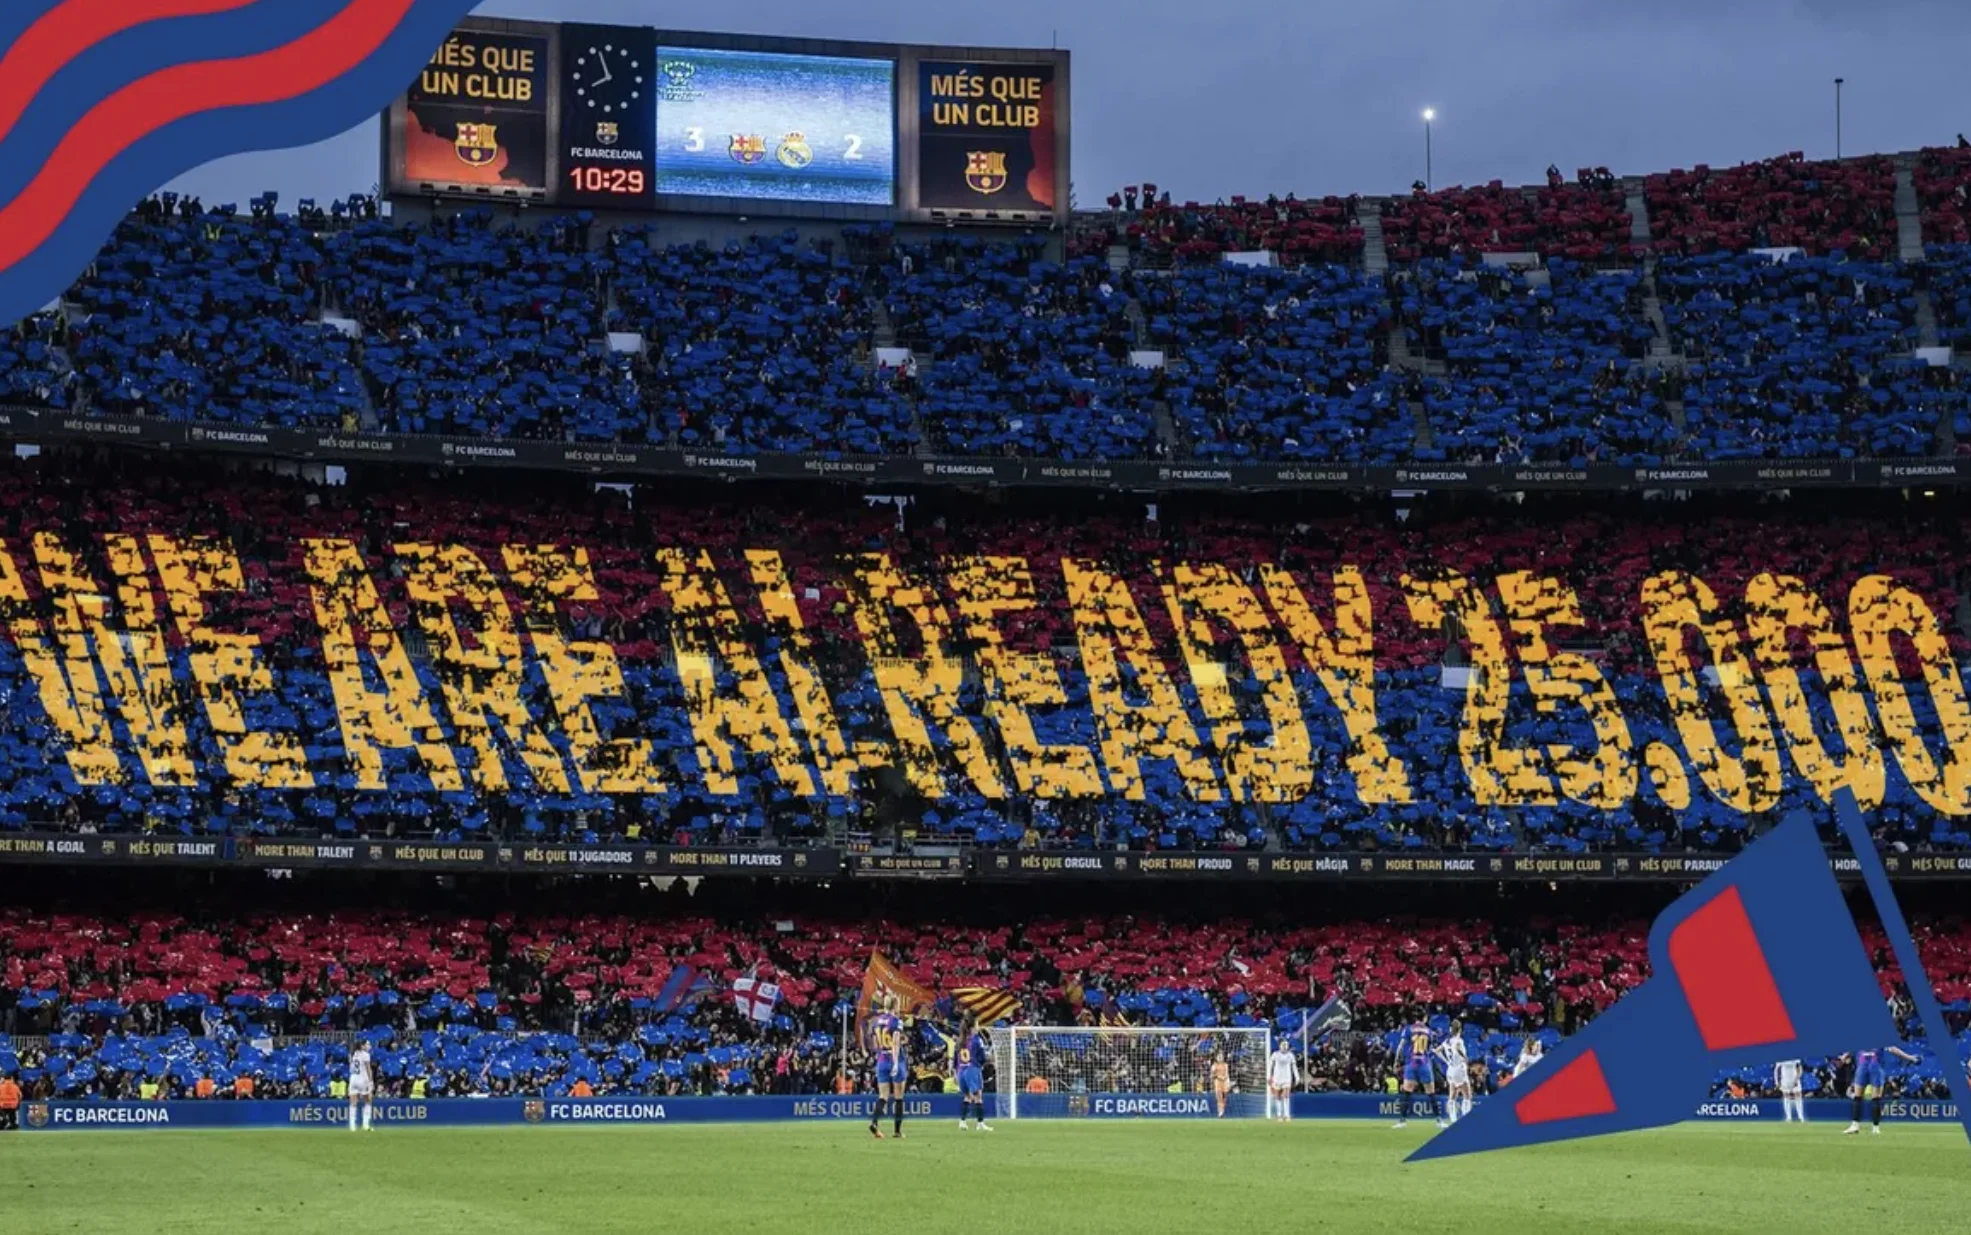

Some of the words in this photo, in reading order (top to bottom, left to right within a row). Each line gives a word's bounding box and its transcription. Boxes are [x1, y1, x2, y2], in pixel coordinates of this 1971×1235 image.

[483, 46, 534, 74] QUE
[422, 70, 458, 96] UN
[466, 74, 532, 100] CLUB
[931, 68, 984, 97] MÉS
[991, 76, 1042, 103] QUE
[933, 103, 968, 125] UN
[976, 104, 1040, 127] CLUB
[684, 126, 704, 152] 3
[842, 134, 862, 159] 2
[571, 148, 583, 157] FC
[585, 148, 643, 160] BARCELONA
[570, 167, 644, 193] 10:29
[84, 423, 102, 434] QUE
[103, 424, 117, 432] UN
[118, 424, 141, 434] CLUB
[206, 430, 216, 440] FC
[217, 431, 268, 443] BARCELONA
[339, 440, 355, 450] QUE
[357, 440, 369, 449] UN
[371, 441, 393, 450] CLUB
[456, 446, 466, 454] FC
[467, 446, 516, 457] BARCELONA
[616, 454, 636, 463] CLUB
[698, 458, 708, 466] FC
[710, 458, 756, 468] BARCELONA
[855, 463, 875, 472] CLUB
[937, 465, 946, 473] FC
[947, 465, 994, 475] BARCELONA
[1092, 469, 1112, 478] CLUB
[1172, 470, 1182, 478] FC
[1183, 470, 1231, 479] BARCELONA
[1649, 471, 1659, 479] FC
[1660, 470, 1708, 479] BARCELONA
[1810, 468, 1831, 477] CLUB
[1895, 466, 1905, 475] FC
[1906, 466, 1956, 475] BARCELONA
[1328, 471, 1348, 480] CLUB
[1410, 472, 1419, 480] FC
[1421, 472, 1467, 480] BARCELONA
[1565, 472, 1587, 480] CLUB
[0, 530, 314, 788] WE
[14, 840, 44, 852] THAN
[46, 842, 55, 852] A
[57, 843, 85, 853] GOAL
[129, 842, 151, 854] MÉS
[152, 843, 176, 857] QUE
[178, 844, 216, 855] TALENT
[254, 844, 285, 856] MORE
[287, 846, 315, 857] THAN
[317, 846, 354, 858] TALENT
[417, 848, 440, 861] QUE
[442, 848, 456, 860] UN
[458, 848, 484, 860] CLUB
[524, 847, 544, 861] MÉS
[546, 850, 567, 864] QUE
[579, 850, 632, 863] JUGADORS
[670, 852, 698, 864] MORE
[701, 853, 728, 864] THAN
[740, 854, 782, 866] PLAYERS
[1021, 856, 1041, 868] MÉS
[1042, 858, 1062, 871] QUE
[1064, 858, 1102, 869] ORGULL
[1140, 858, 1167, 870] MORE
[1169, 858, 1196, 870] THAN
[1198, 858, 1232, 870] PROUD
[1272, 858, 1292, 870] MÉS
[1293, 860, 1313, 872] QUE
[1385, 859, 1413, 870] MORE
[1416, 859, 1442, 870] THAN
[1444, 859, 1475, 870] MAGIC
[1536, 859, 1556, 873] QUE
[1560, 859, 1574, 870] UN
[1576, 859, 1601, 870] CLUB
[1640, 858, 1660, 870] MÉS
[1661, 859, 1682, 873] QUE
[1684, 860, 1730, 871] PARAU
[1912, 858, 1933, 870] MÉS
[1935, 858, 1955, 872] QUE
[1412, 1034, 1429, 1054] 10
[550, 1104, 569, 1119] FC
[572, 1104, 665, 1119] BARCELONA
[794, 1099, 826, 1116] MÉS
[830, 1101, 861, 1117] QUE
[1095, 1099, 1114, 1113] FC
[1116, 1099, 1210, 1113] BARCELONA
[1380, 1098, 1409, 1114] MÉ
[1696, 1104, 1759, 1116] RCELONA
[1910, 1103, 1938, 1119] QUE
[54, 1108, 73, 1122] FC
[76, 1108, 169, 1122] BARCELONA
[289, 1104, 321, 1121] MÉS
[326, 1106, 349, 1123] QU
[388, 1106, 427, 1119] CLUB
